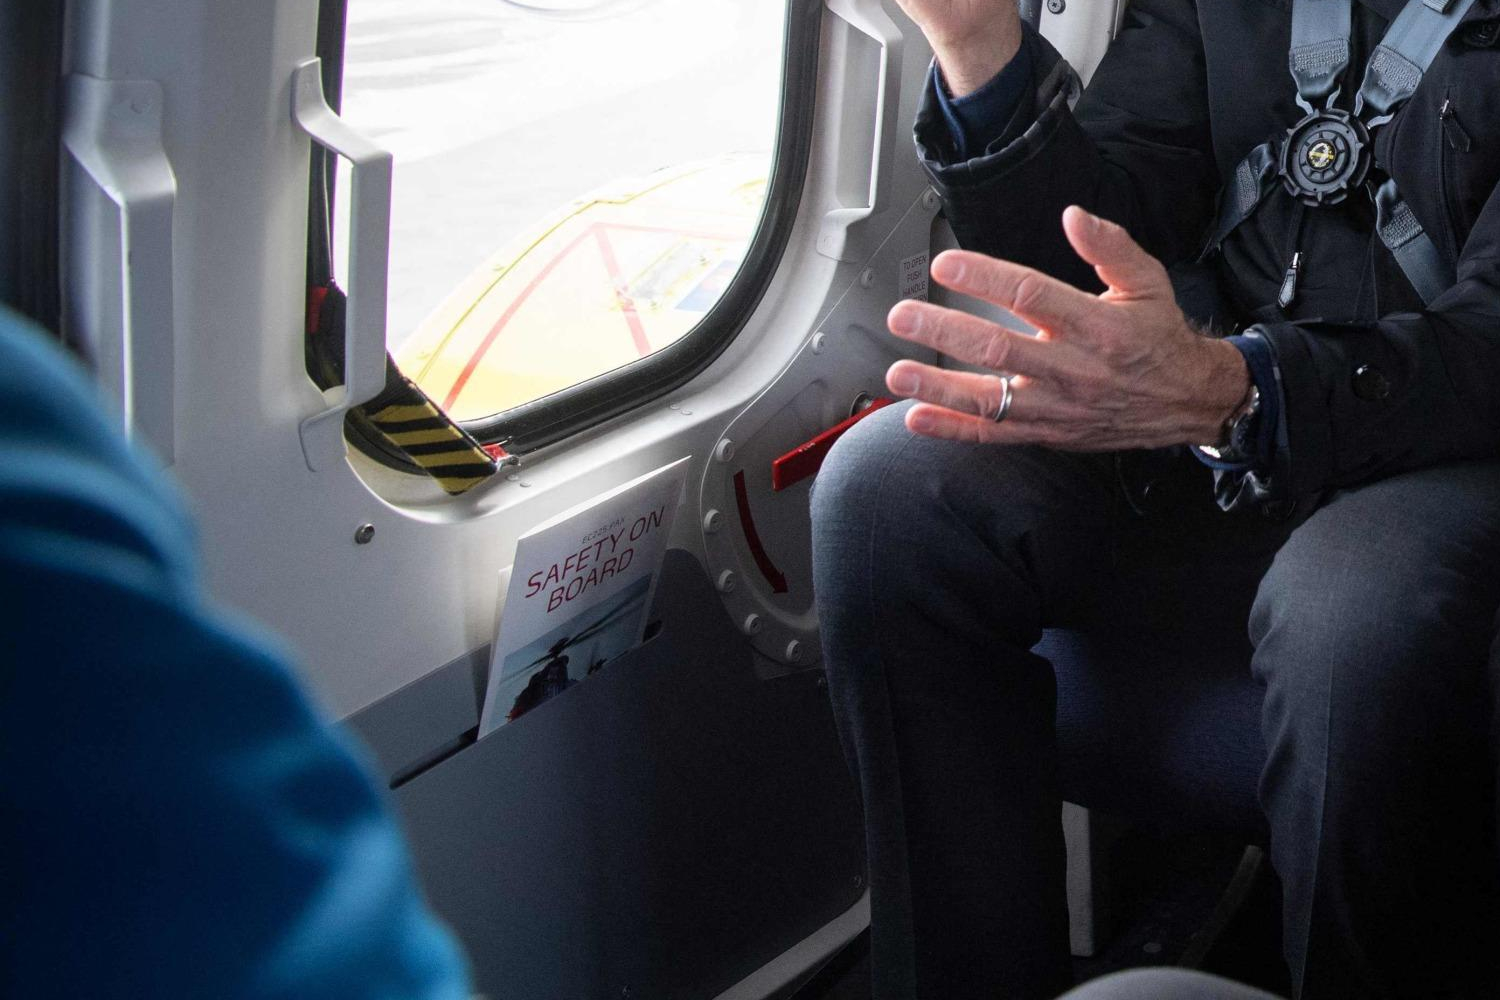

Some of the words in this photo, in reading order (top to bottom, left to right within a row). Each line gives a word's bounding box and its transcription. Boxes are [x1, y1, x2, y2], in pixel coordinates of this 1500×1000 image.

[524, 527, 626, 599] SAFETY
[629, 505, 665, 542] ON
[546, 548, 634, 614] BOARD
